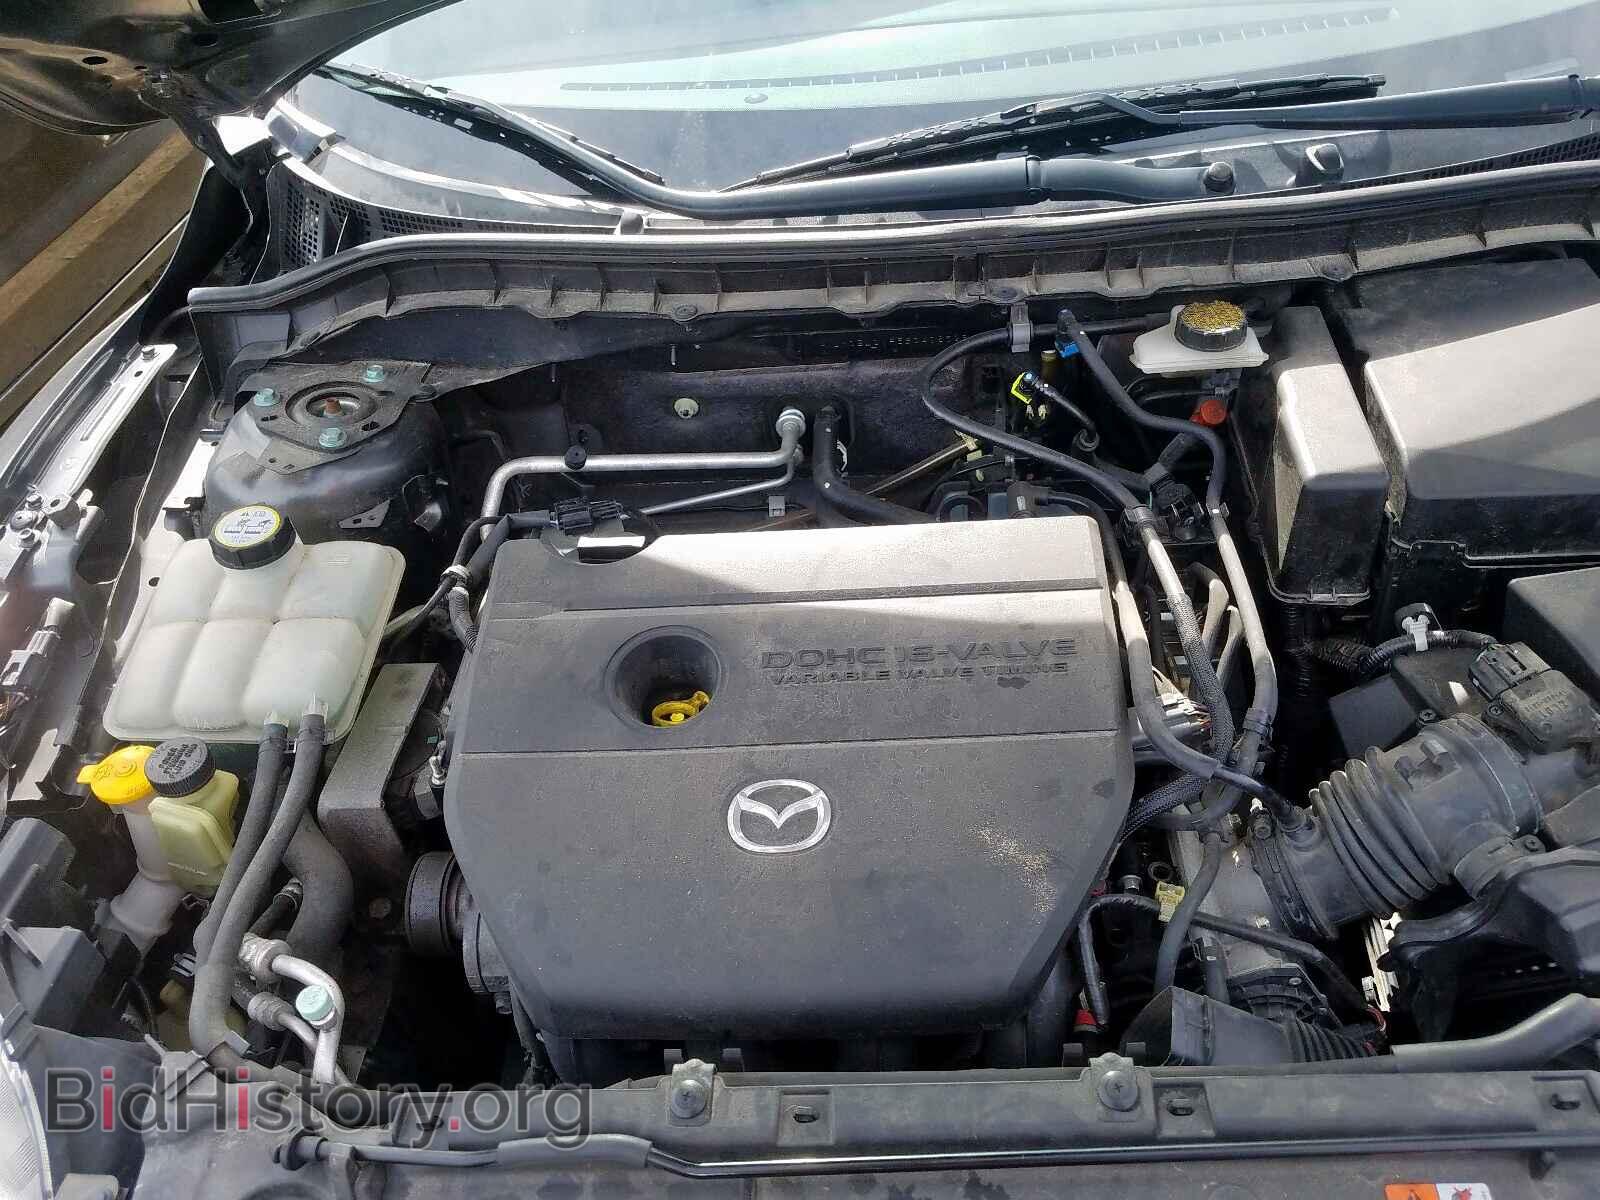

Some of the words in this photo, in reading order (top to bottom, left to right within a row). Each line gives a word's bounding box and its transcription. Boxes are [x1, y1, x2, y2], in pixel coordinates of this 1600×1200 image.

[761, 646, 885, 669] DOHC
[769, 668, 890, 686] VARIABLE
[901, 665, 974, 681] VALVE
